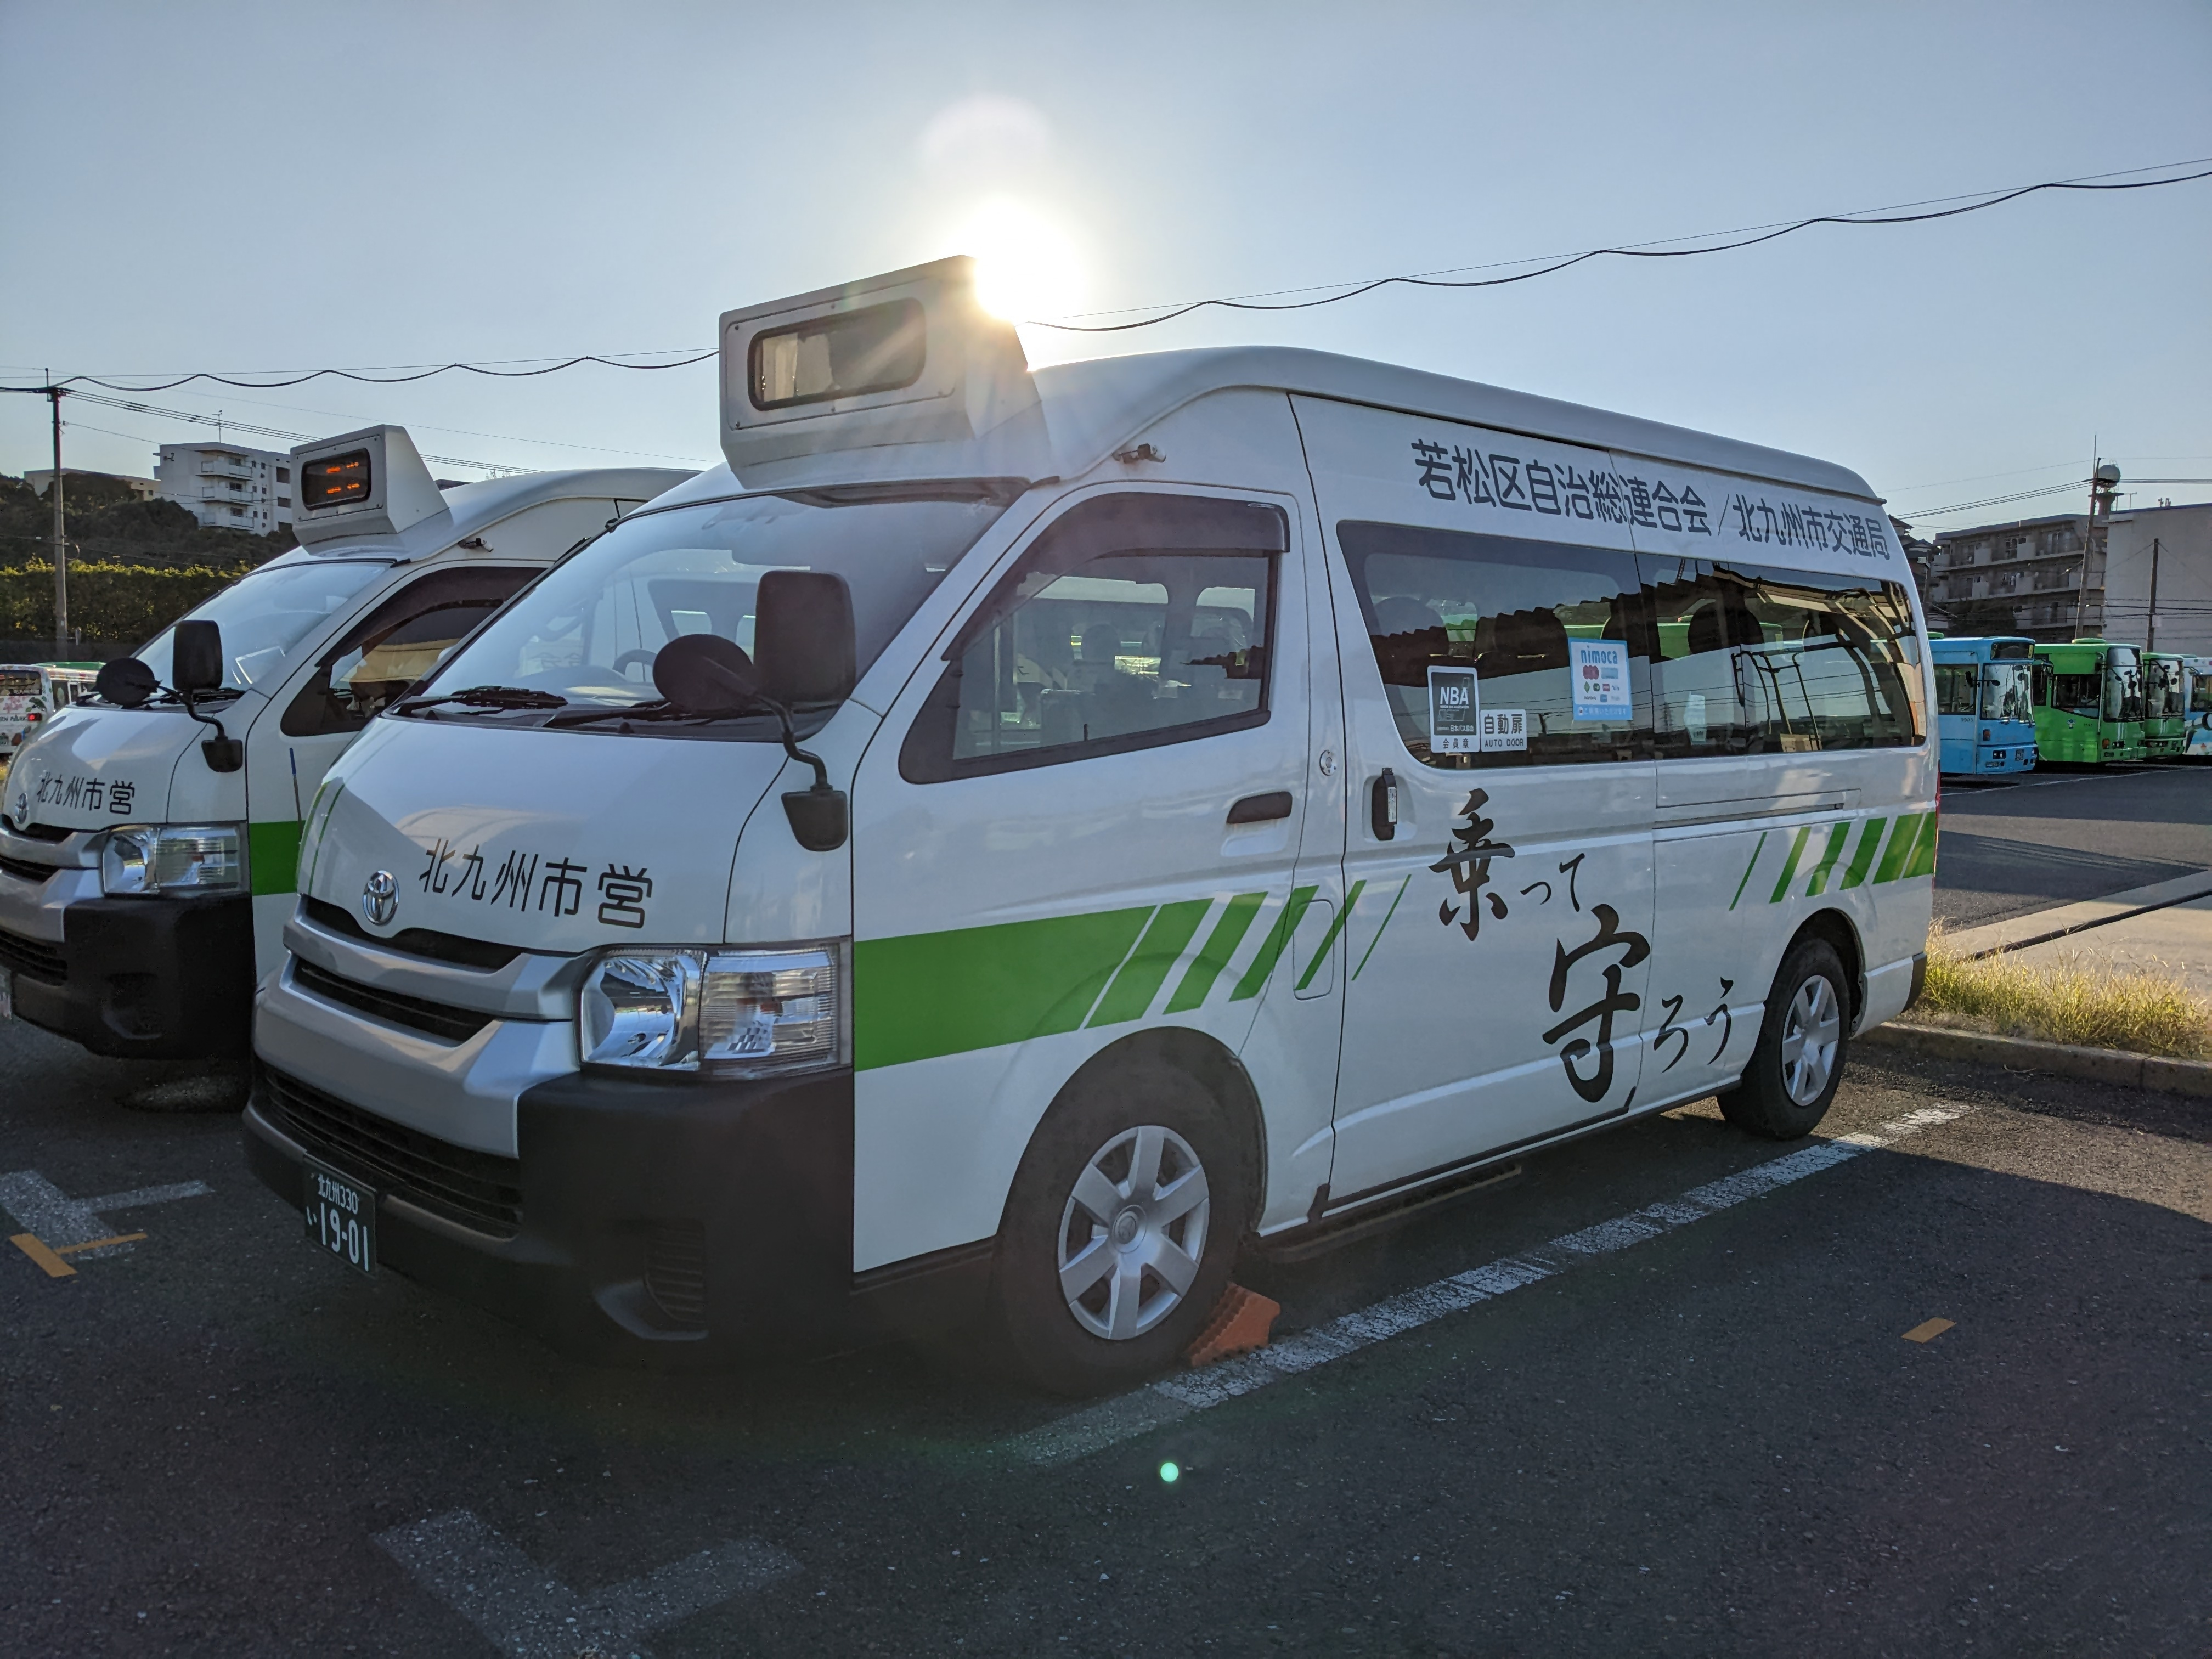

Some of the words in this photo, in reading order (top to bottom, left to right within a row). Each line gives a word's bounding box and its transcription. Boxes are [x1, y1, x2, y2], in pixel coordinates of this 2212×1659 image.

[1581, 645, 1618, 664] nimoca
[1440, 686, 1469, 705] NBA
[1484, 713, 1522, 734] 自動扉
[1442, 738, 1469, 749] 会員章
[1485, 739, 1503, 747] AUTO
[1506, 738, 1523, 747] DOOR
[37, 771, 136, 815] 北九州市営
[419, 838, 653, 929] 北九州市営
[320, 1202, 369, 1272] 19-01
